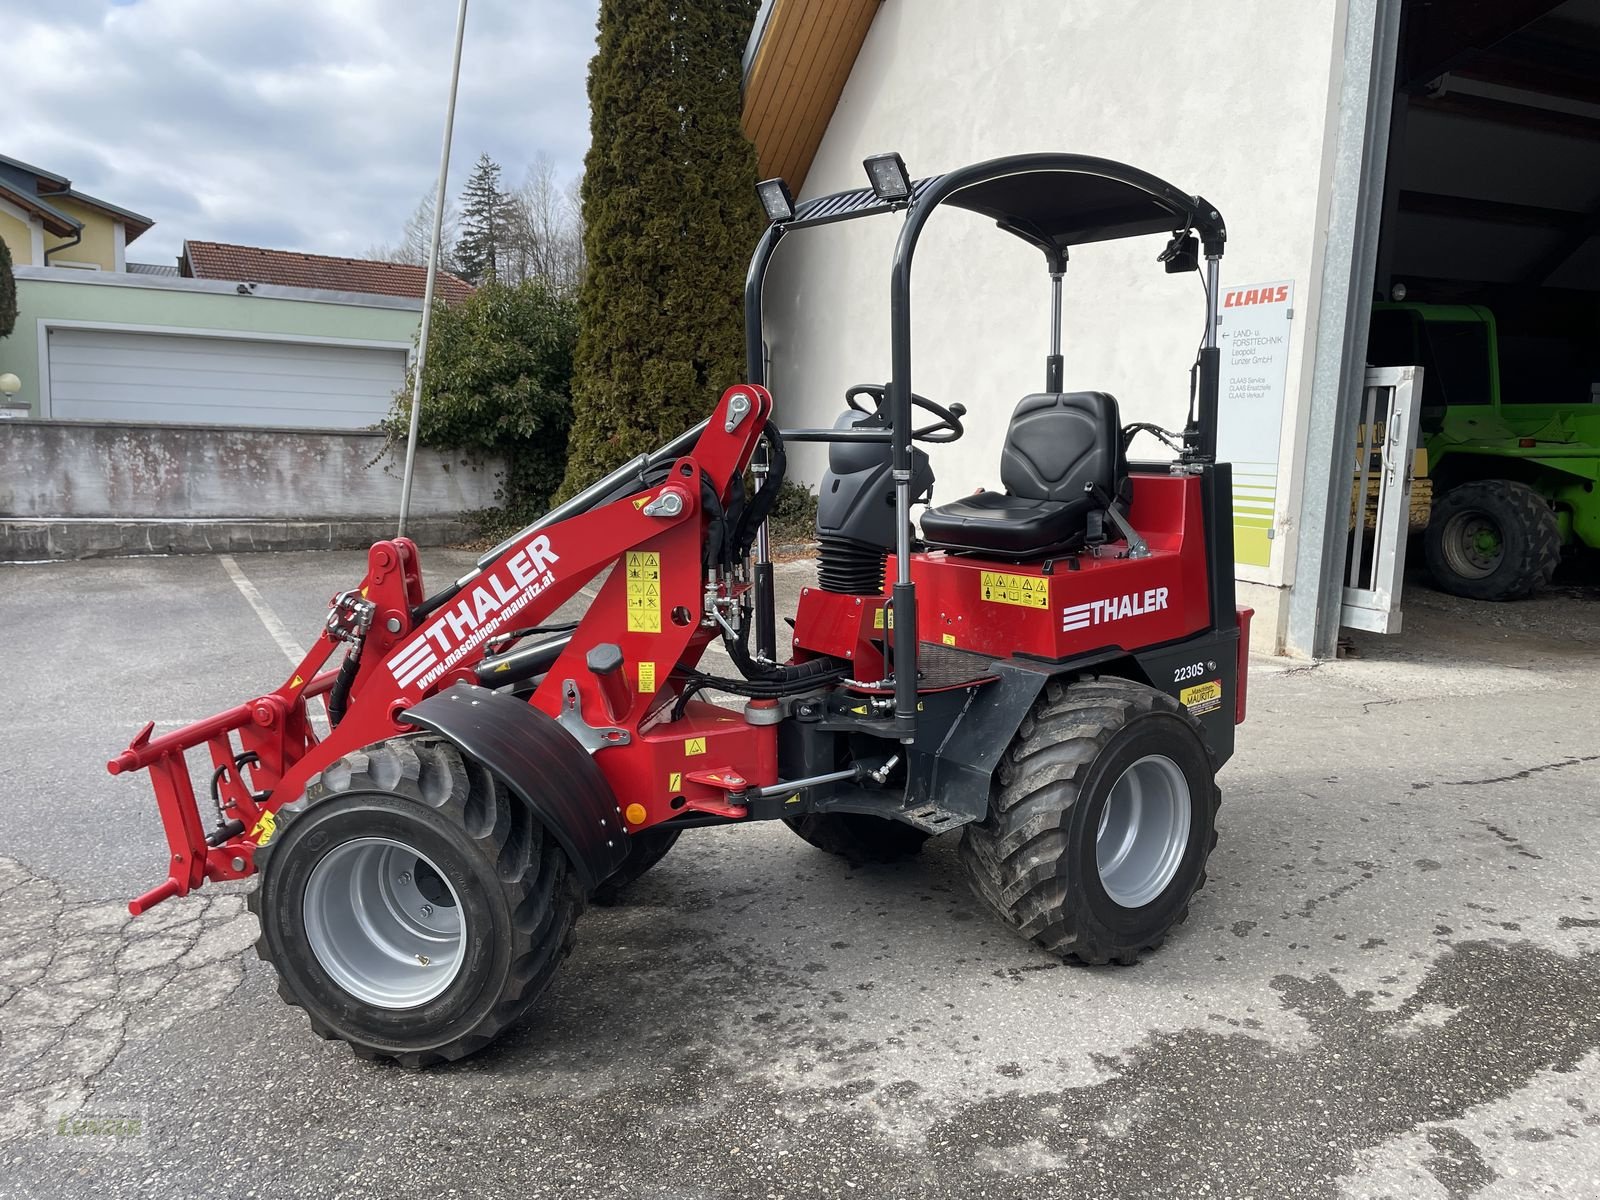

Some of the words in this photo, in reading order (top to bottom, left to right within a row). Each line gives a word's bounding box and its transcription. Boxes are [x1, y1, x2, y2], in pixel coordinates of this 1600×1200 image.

[1224, 285, 1288, 308] CLAAS
[1232, 336, 1283, 347] FORSTTECHNIK
[1233, 329, 1253, 338] LAND-
[1232, 348, 1256, 357] Leopold
[1252, 355, 1273, 364] GmbH
[1229, 377, 1247, 385] CLAAS
[1248, 376, 1266, 384] Service
[425, 534, 560, 653] THALER
[1090, 587, 1169, 625] THALER
[416, 570, 556, 691] www.maschinen-mauritz.at
[1174, 661, 1204, 683] 2230S
